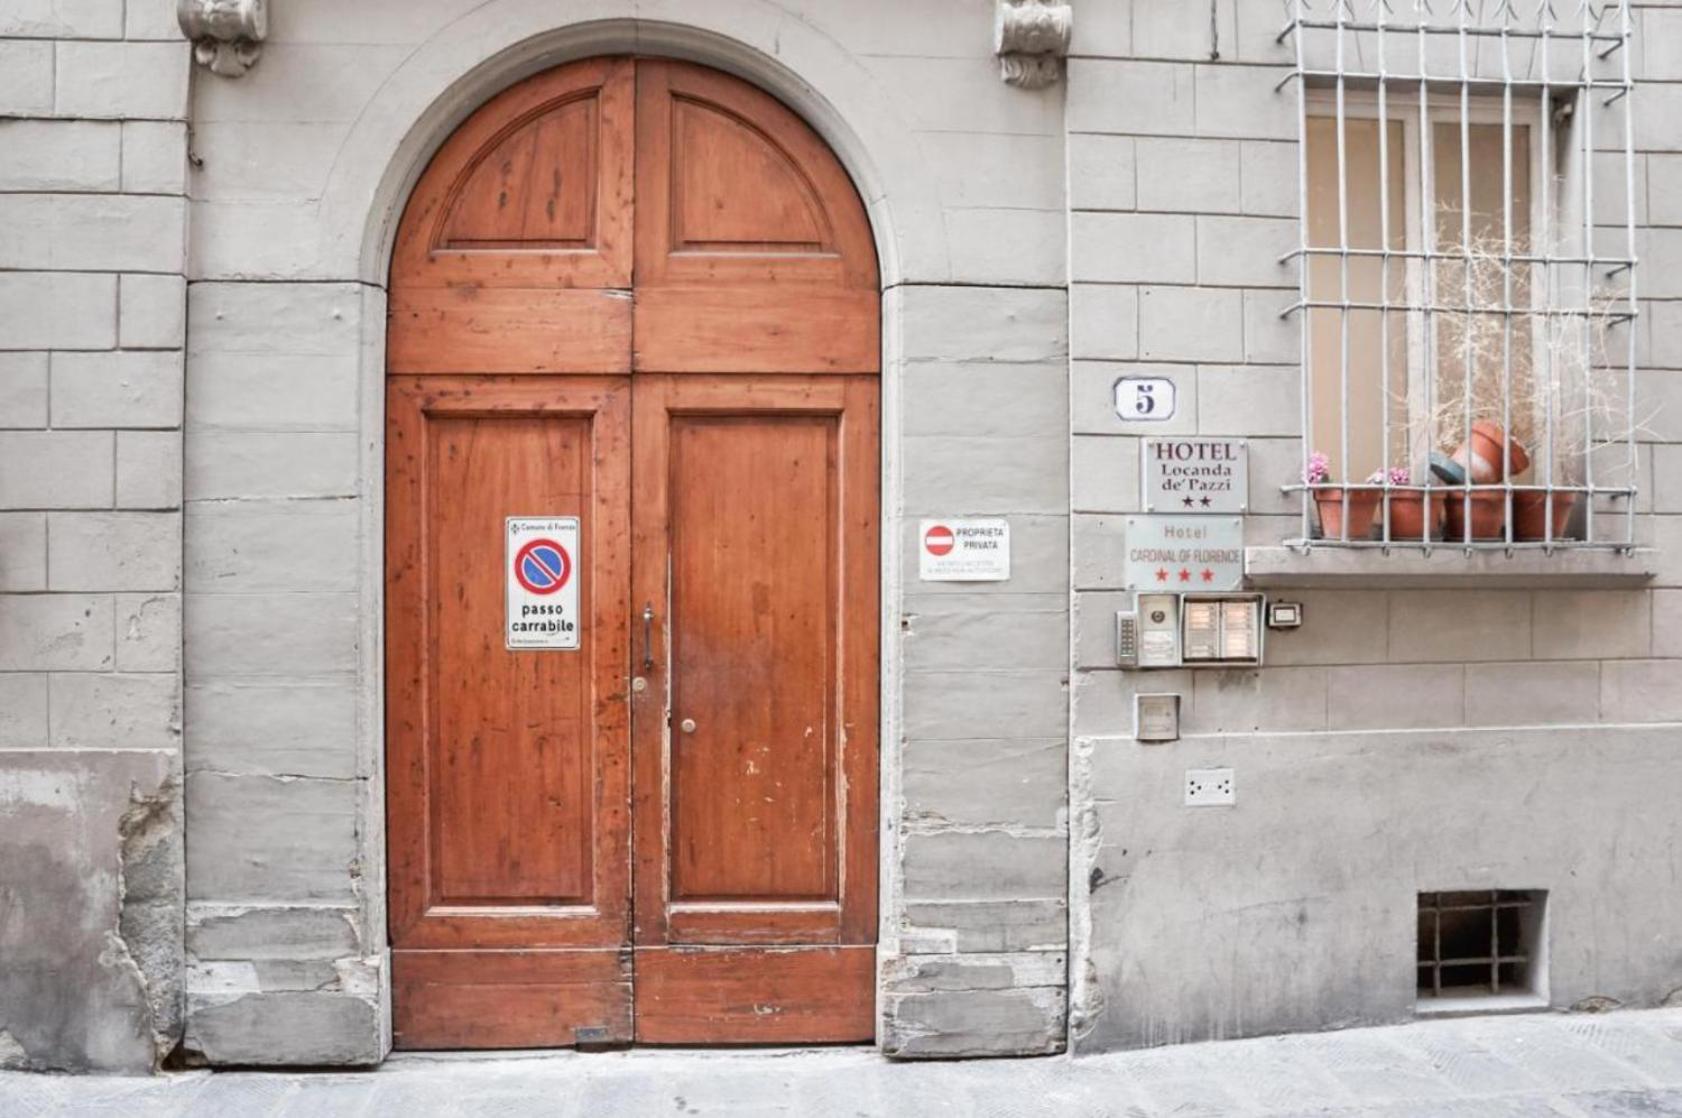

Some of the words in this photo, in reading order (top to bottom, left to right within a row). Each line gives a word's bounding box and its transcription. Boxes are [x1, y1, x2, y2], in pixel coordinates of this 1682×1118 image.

[1136, 384, 1155, 415] 5
[1156, 442, 1237, 461] HOTEL
[1161, 463, 1232, 476] Locanda
[1164, 525, 1207, 539] Hotel
[963, 540, 998, 550] PRIVATA
[1130, 549, 1176, 562] CARDINAL
[1179, 549, 1191, 562] OF
[1193, 549, 1240, 563] FLORENCE
[522, 604, 563, 618] passo
[511, 619, 574, 632] carrabile
